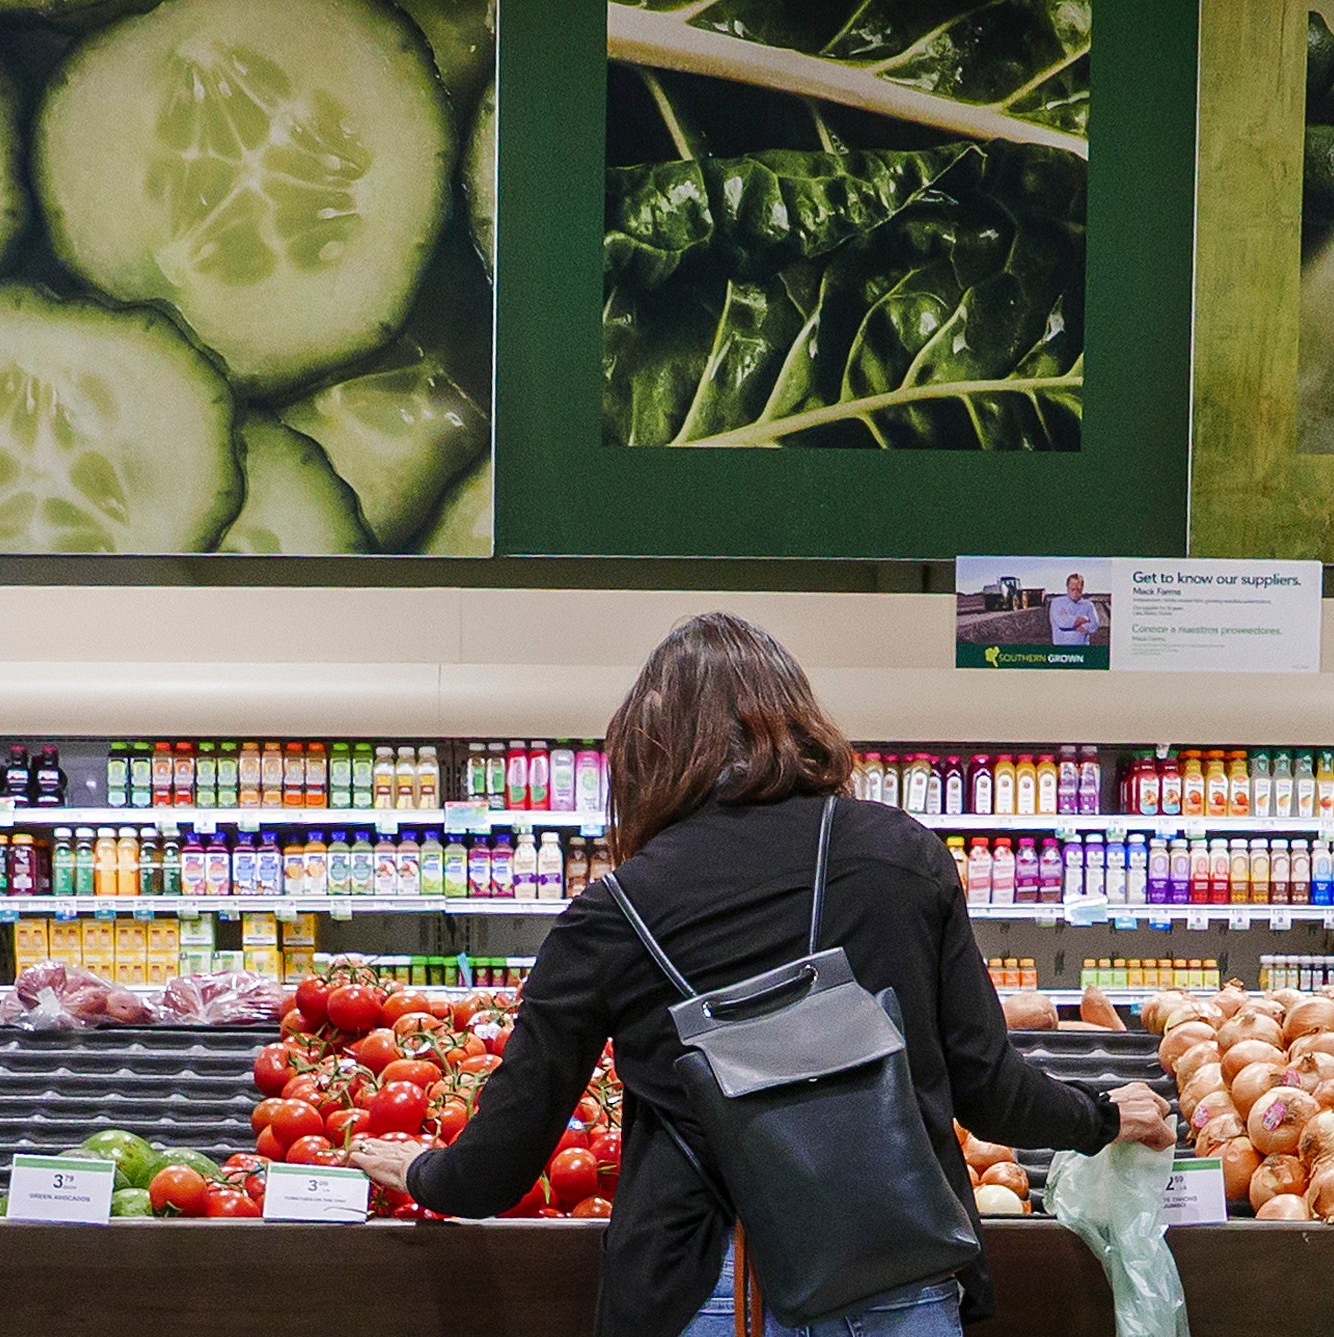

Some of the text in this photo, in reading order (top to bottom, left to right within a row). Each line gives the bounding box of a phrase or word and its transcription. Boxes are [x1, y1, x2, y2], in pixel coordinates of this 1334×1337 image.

[1133, 571, 1302, 589] Get to know our suppliers.
[1047, 654, 1084, 663] GROWN
